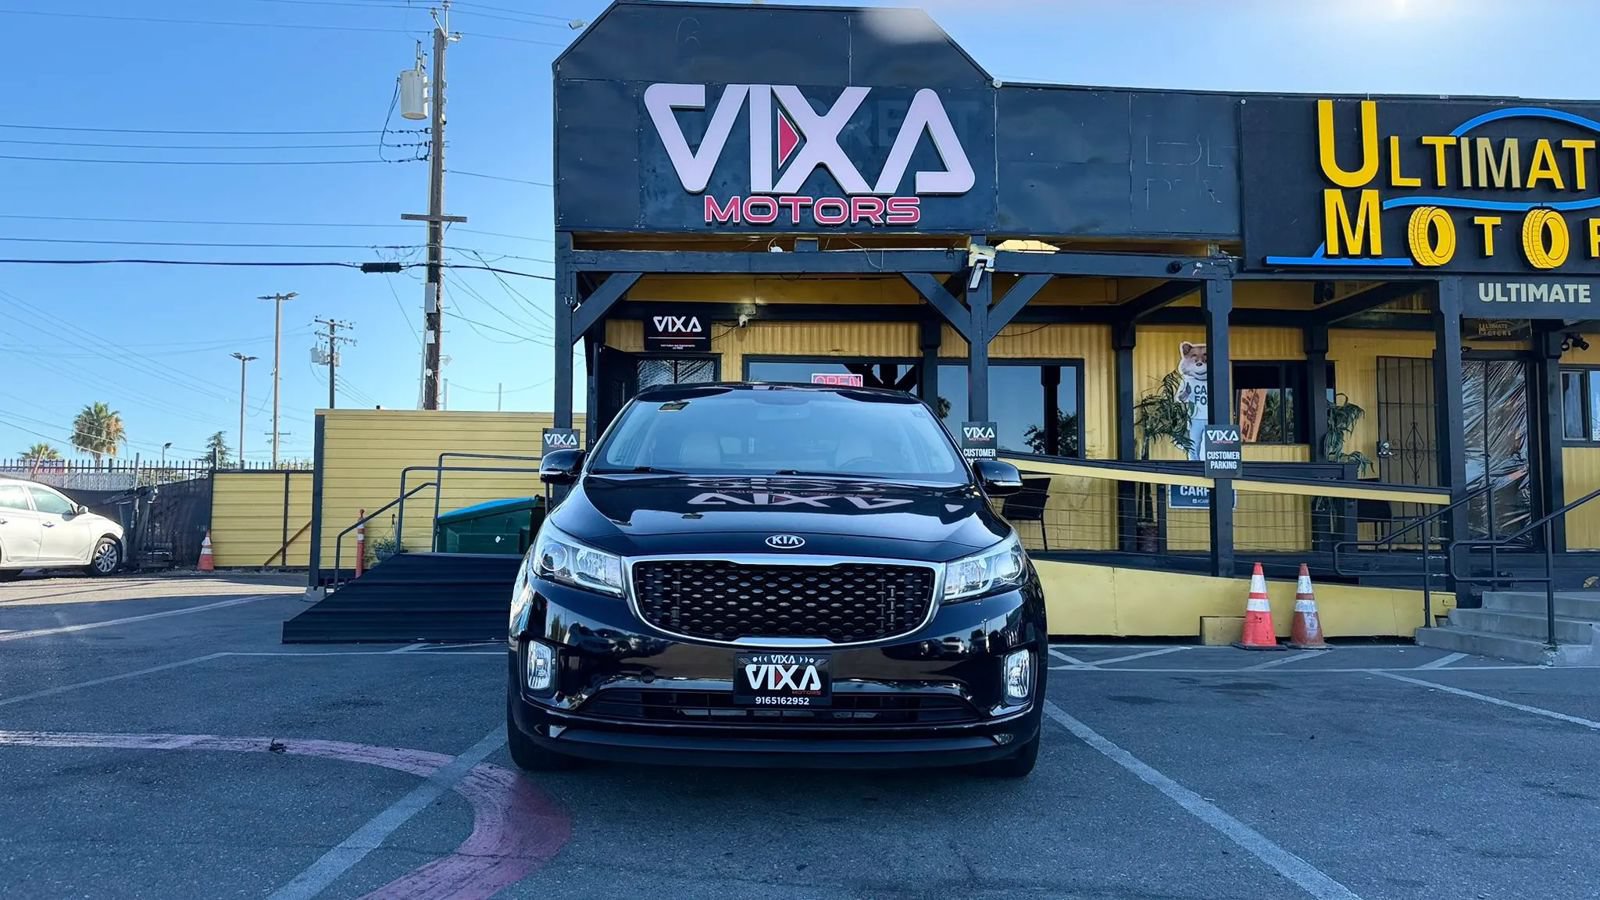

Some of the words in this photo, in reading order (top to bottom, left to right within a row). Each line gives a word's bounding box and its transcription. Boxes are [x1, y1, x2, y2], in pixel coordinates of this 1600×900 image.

[644, 83, 976, 195] VIXA
[1318, 99, 1597, 190] ULTIMAT
[704, 195, 921, 225] MOTORS
[1478, 282, 1592, 303] ULTIMATE
[653, 315, 703, 332] VIXA
[1194, 385, 1207, 395] CA
[1194, 395, 1207, 405] FO
[963, 427, 995, 438] VIXA
[1206, 430, 1239, 441] VIXA
[544, 433, 578, 445] VIXA
[963, 448, 996, 457] CUSTOMER
[1206, 451, 1240, 460] CUSTOMER
[1210, 460, 1238, 469] PARKING
[772, 535, 799, 545] KIA
[770, 654, 796, 664] VIXA
[745, 664, 821, 690] VIXA
[755, 696, 810, 705] 9165162952
